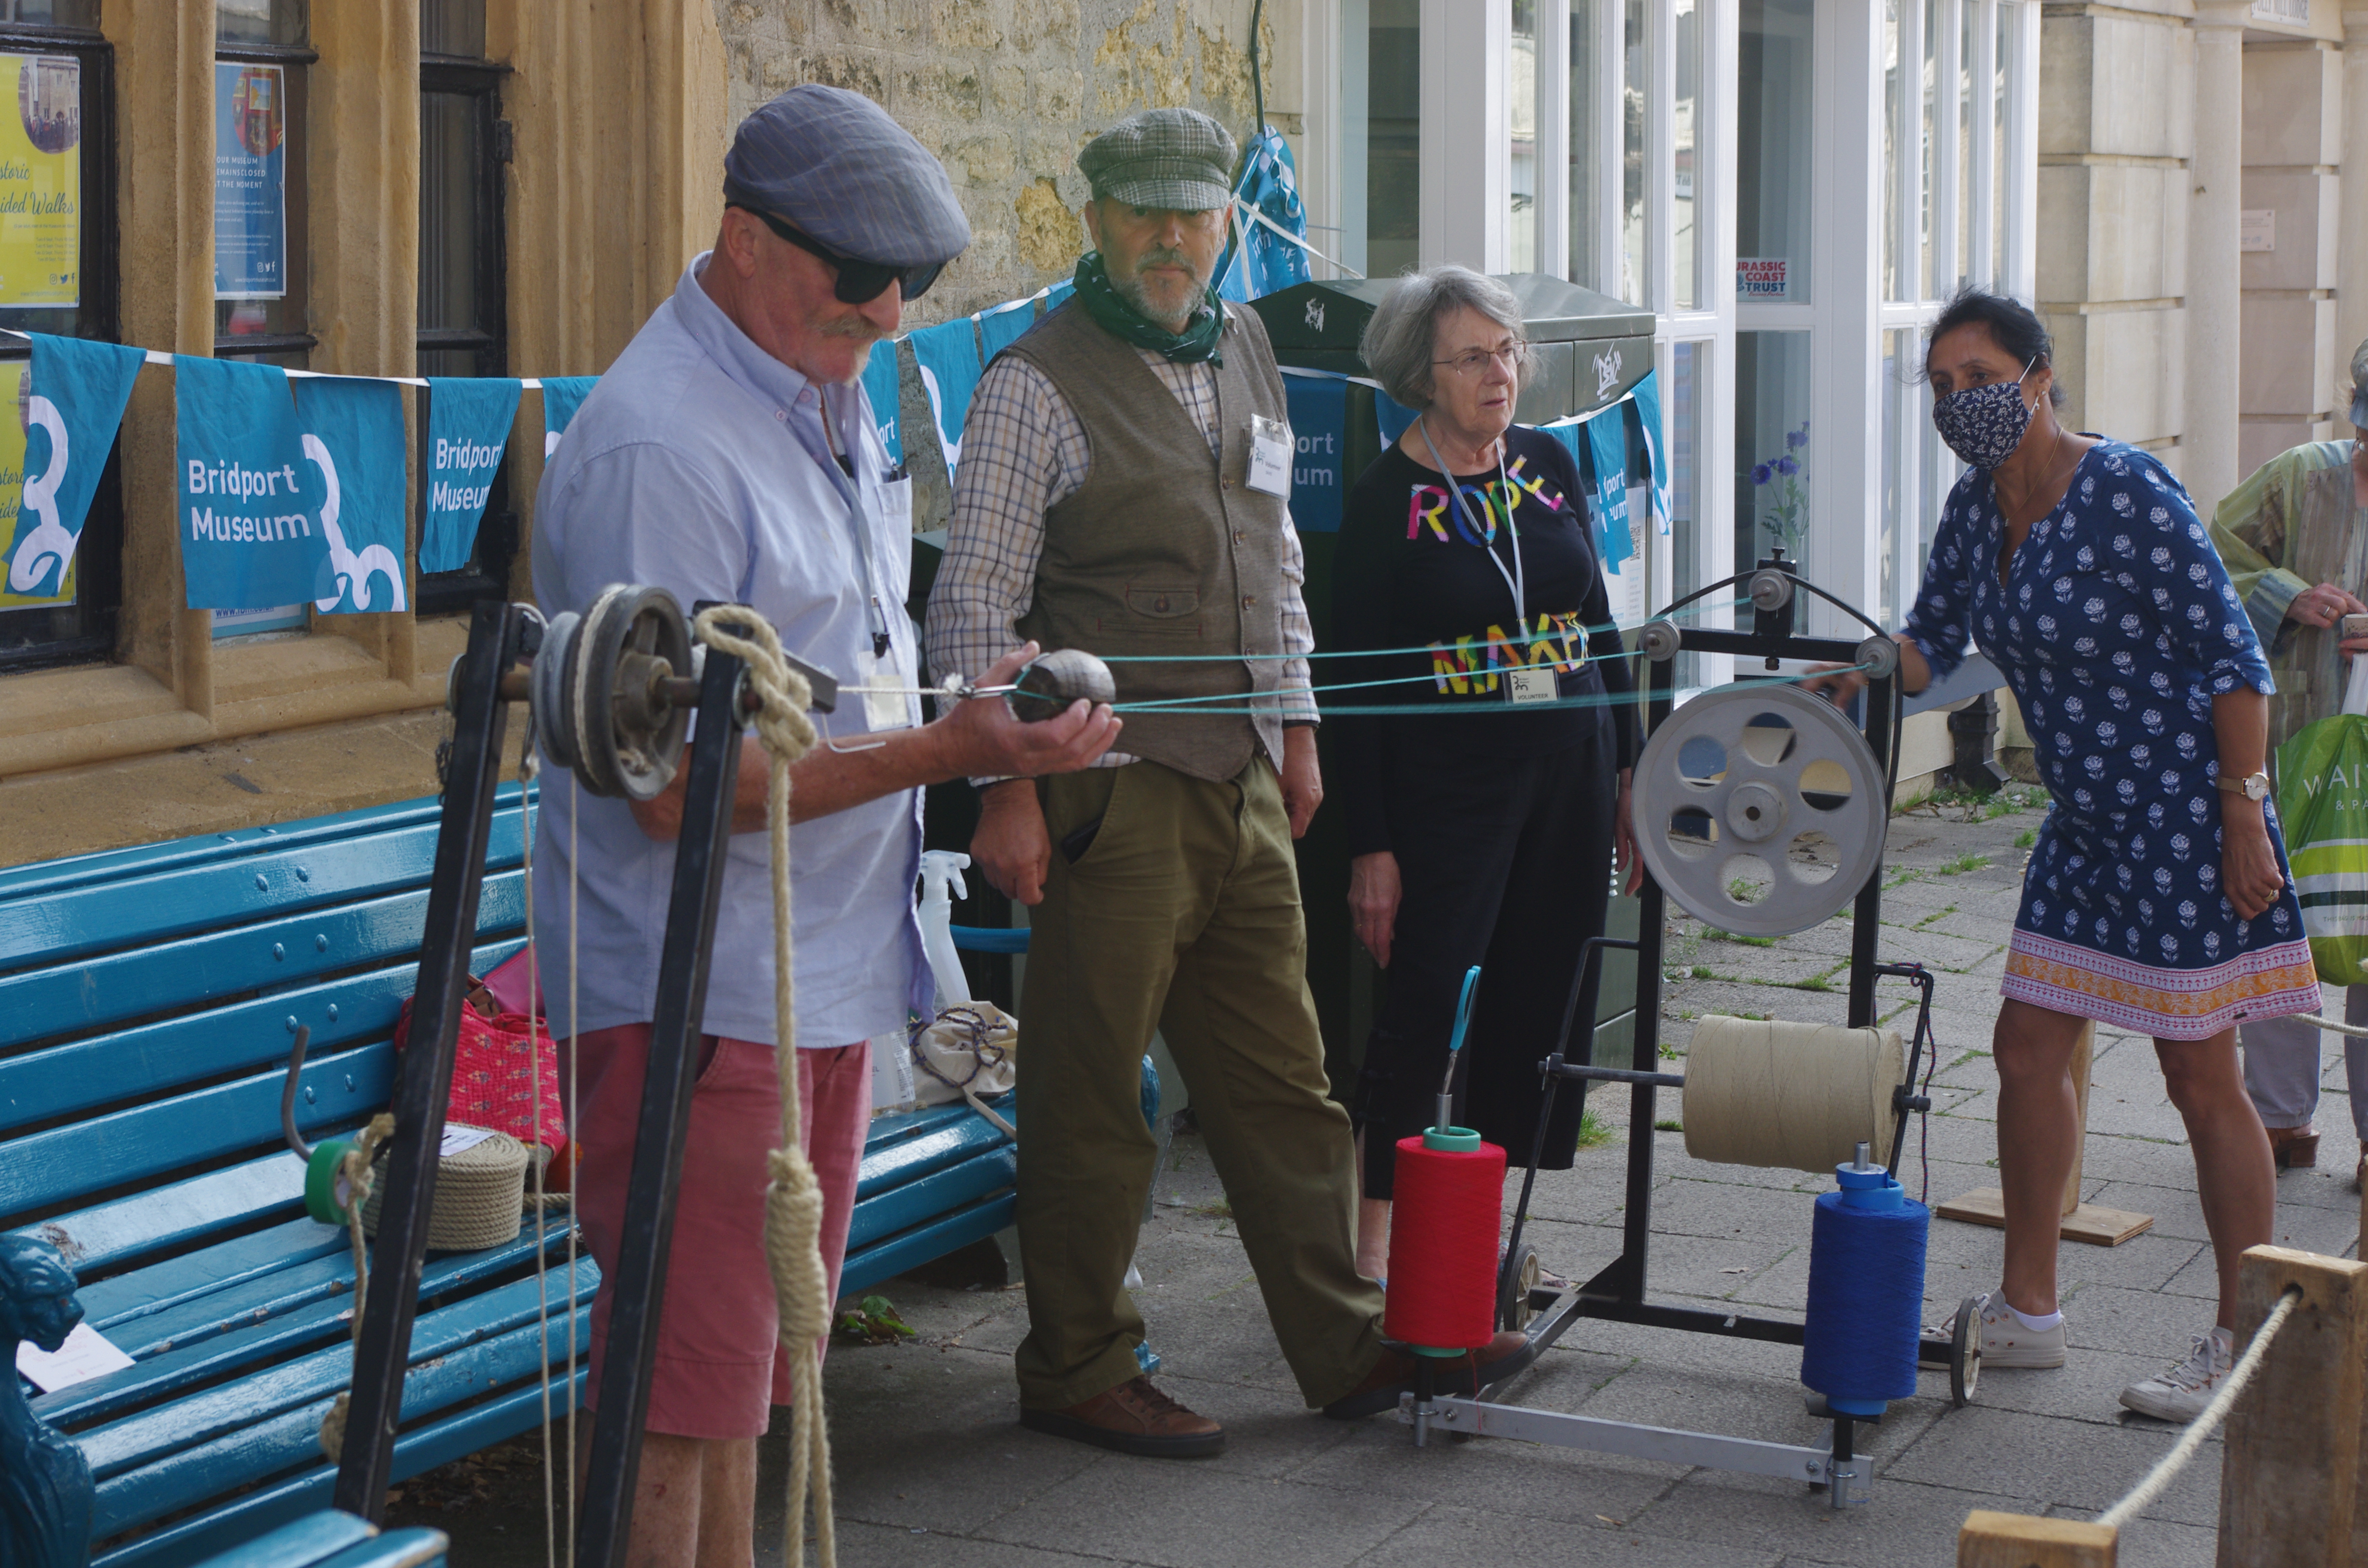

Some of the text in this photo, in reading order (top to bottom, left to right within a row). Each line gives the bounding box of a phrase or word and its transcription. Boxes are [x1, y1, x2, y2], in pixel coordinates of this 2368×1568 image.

[30, 192, 75, 215] Walks
[1745, 272, 1786, 282] COAST
[1745, 282, 1786, 292] TRUST
[436, 437, 504, 476] Bridport
[189, 459, 299, 504] Bridport
[1406, 454, 1564, 548] ROPE
[191, 507, 311, 542] Museum
[2303, 763, 2368, 799] WAI
